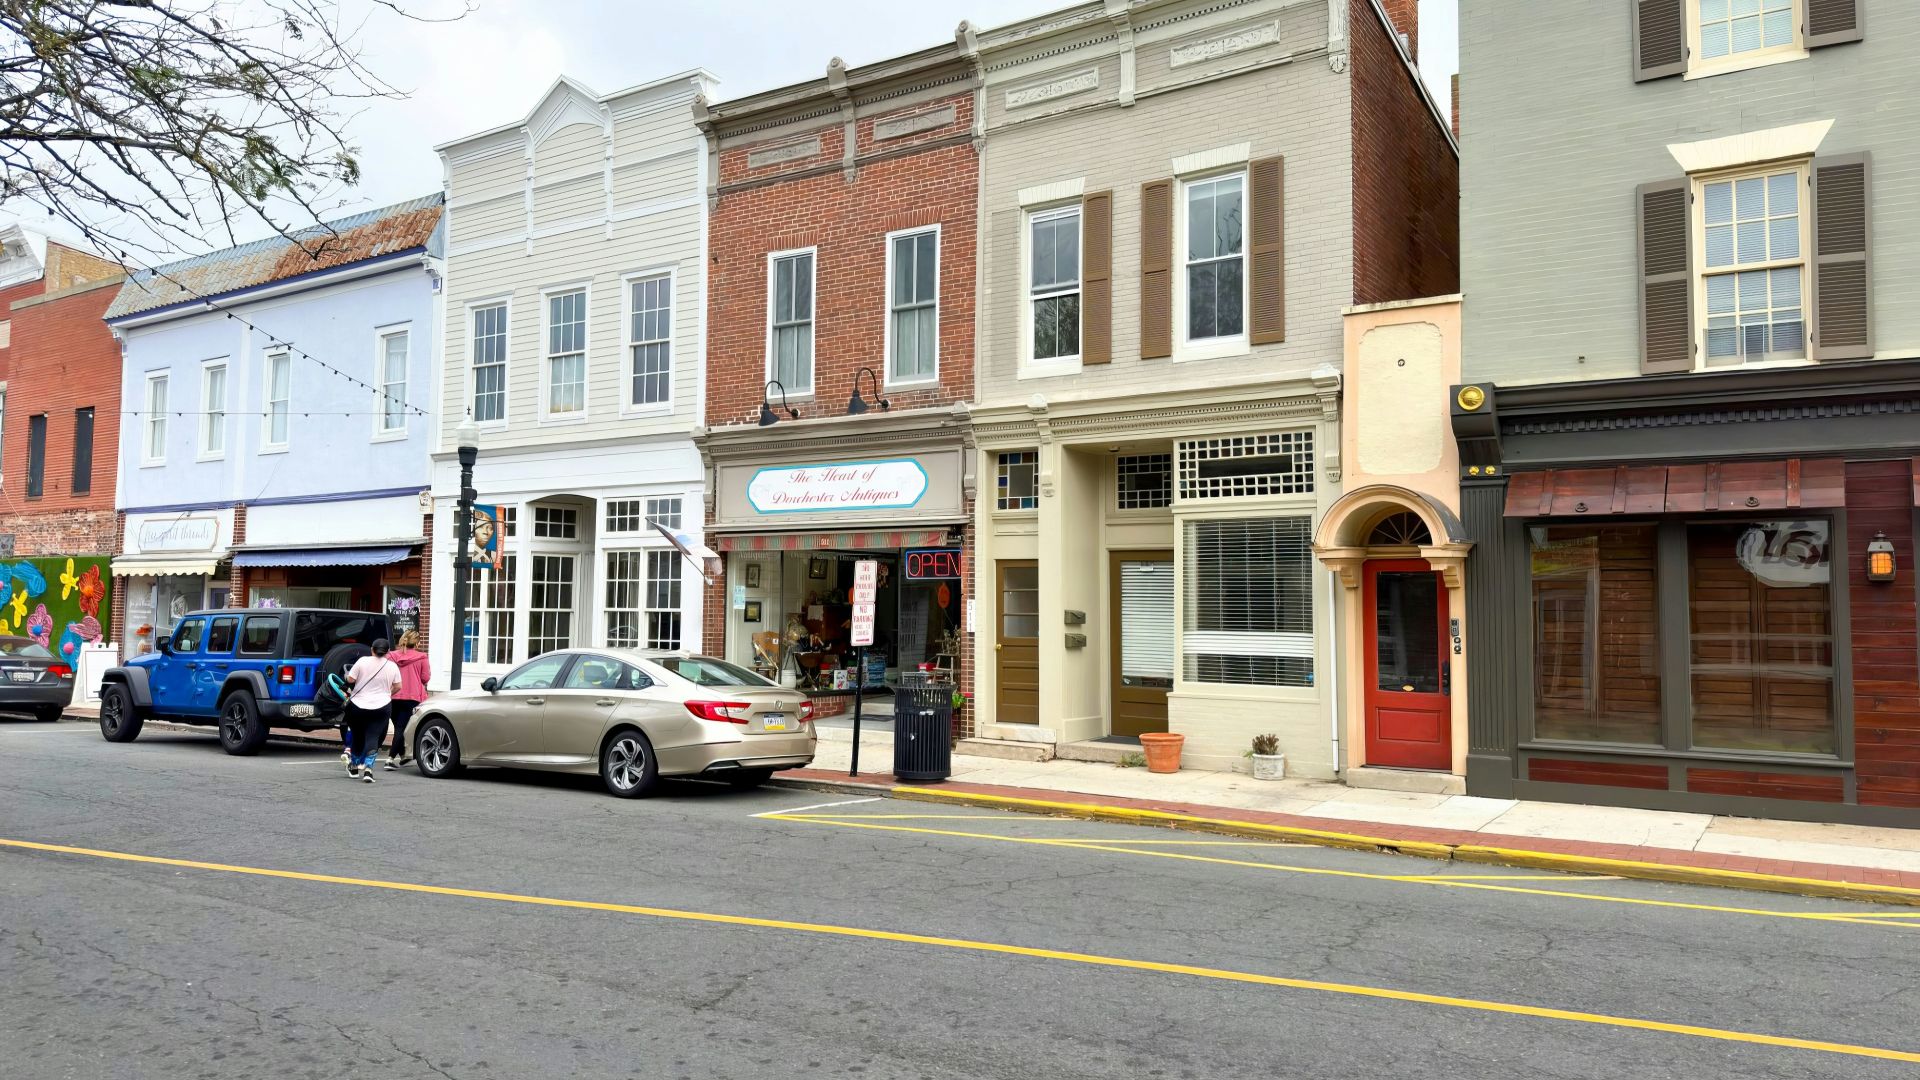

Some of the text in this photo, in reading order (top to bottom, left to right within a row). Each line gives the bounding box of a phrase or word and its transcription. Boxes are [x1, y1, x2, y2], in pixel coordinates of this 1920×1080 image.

[787, 464, 878, 483] The Heart of
[772, 487, 899, 504] Dorchester Antiques
[908, 552, 962, 578] OPEN
[859, 605, 868, 613] NO
[853, 615, 873, 623] PARKING
